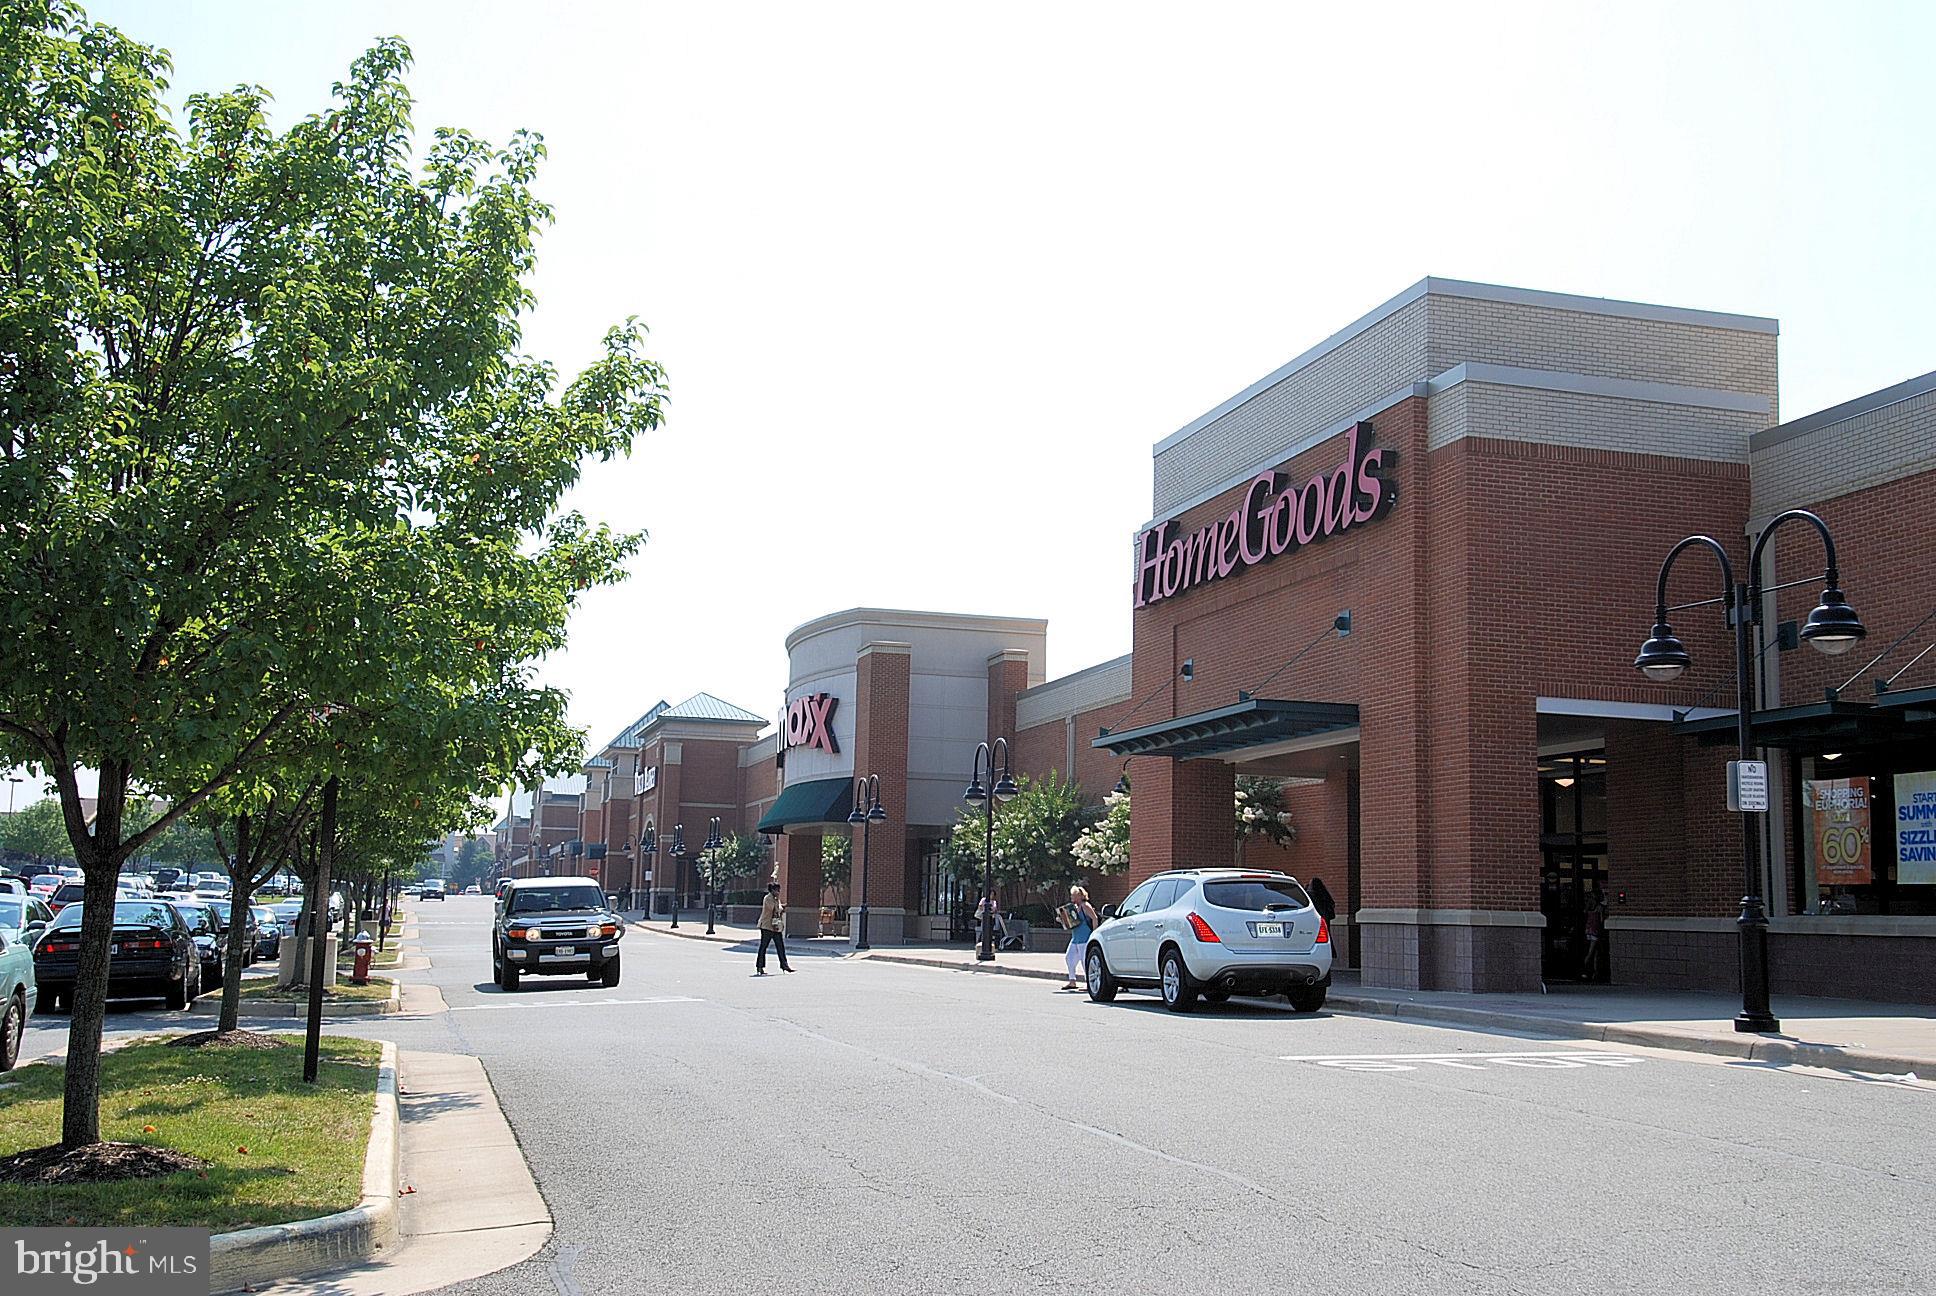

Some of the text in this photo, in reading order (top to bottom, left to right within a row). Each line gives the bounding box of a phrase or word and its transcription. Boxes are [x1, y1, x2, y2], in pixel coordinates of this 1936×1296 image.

[1134, 421, 1386, 609] HomeGoods
[1747, 764, 1757, 774] NO
[1819, 787, 1864, 800] SHOPPING
[1815, 798, 1868, 811] EUPHORIA!
